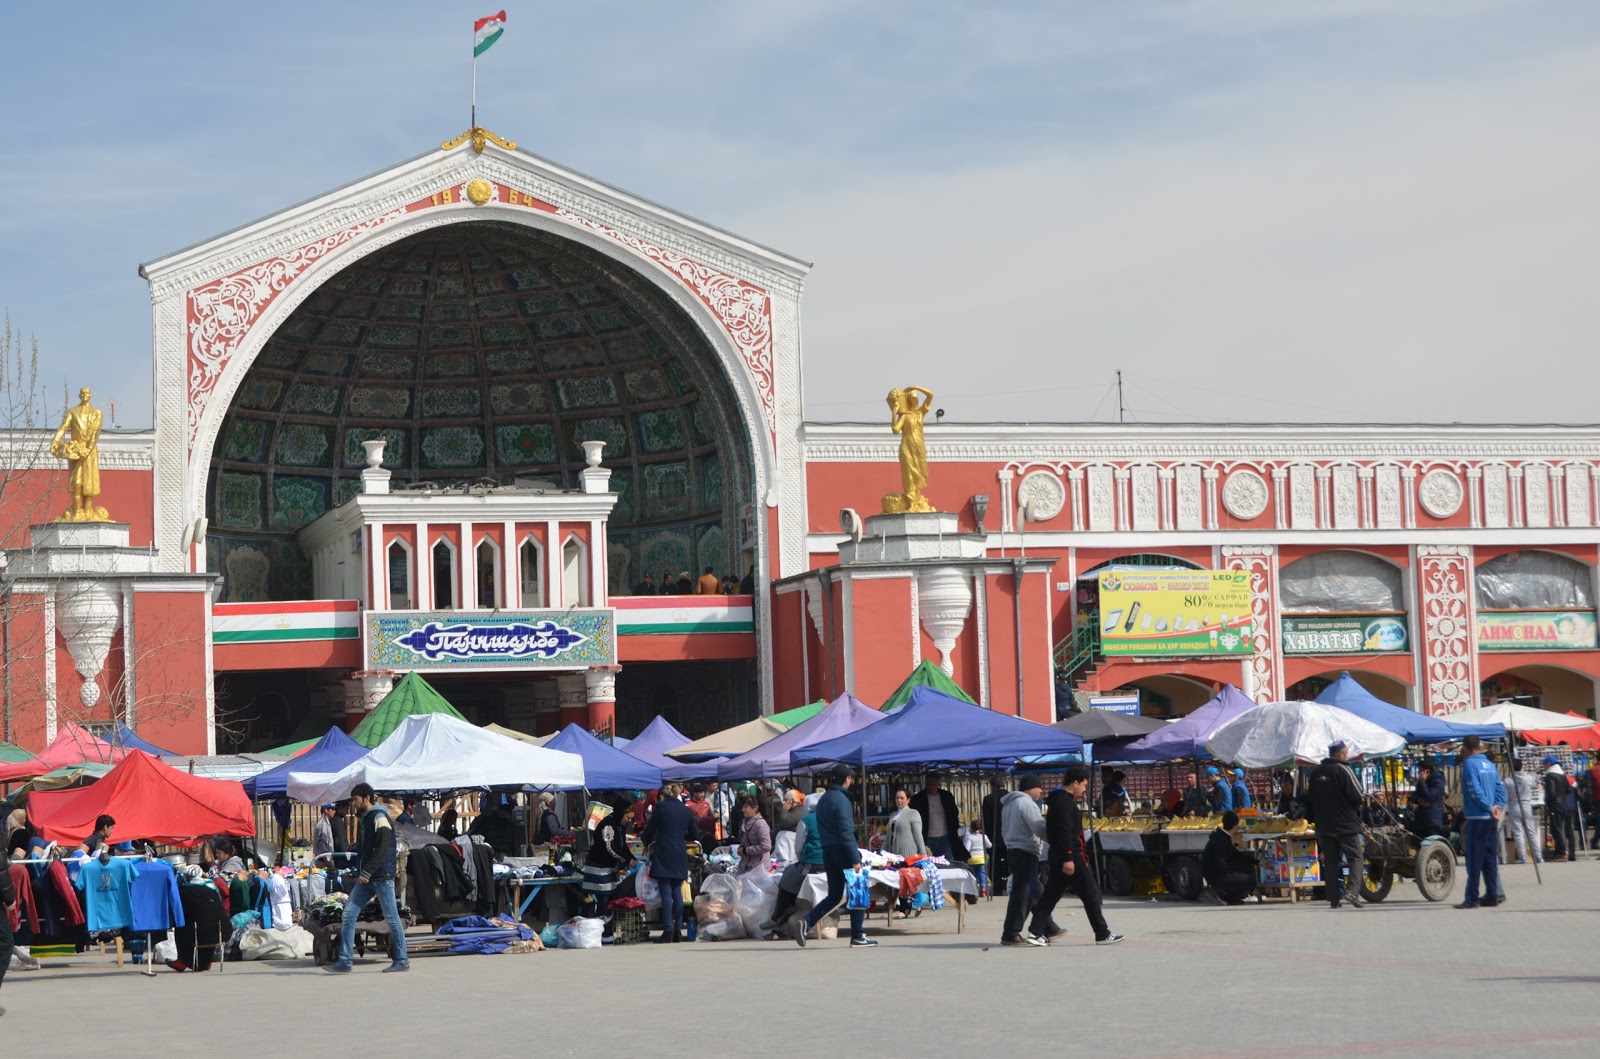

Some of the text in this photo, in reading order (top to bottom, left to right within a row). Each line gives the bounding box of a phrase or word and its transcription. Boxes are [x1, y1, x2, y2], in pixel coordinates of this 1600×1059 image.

[431, 188, 532, 207] 19 64
[1184, 594, 1213, 608] 80%
[1478, 624, 1557, 640] ЛИМОНАД
